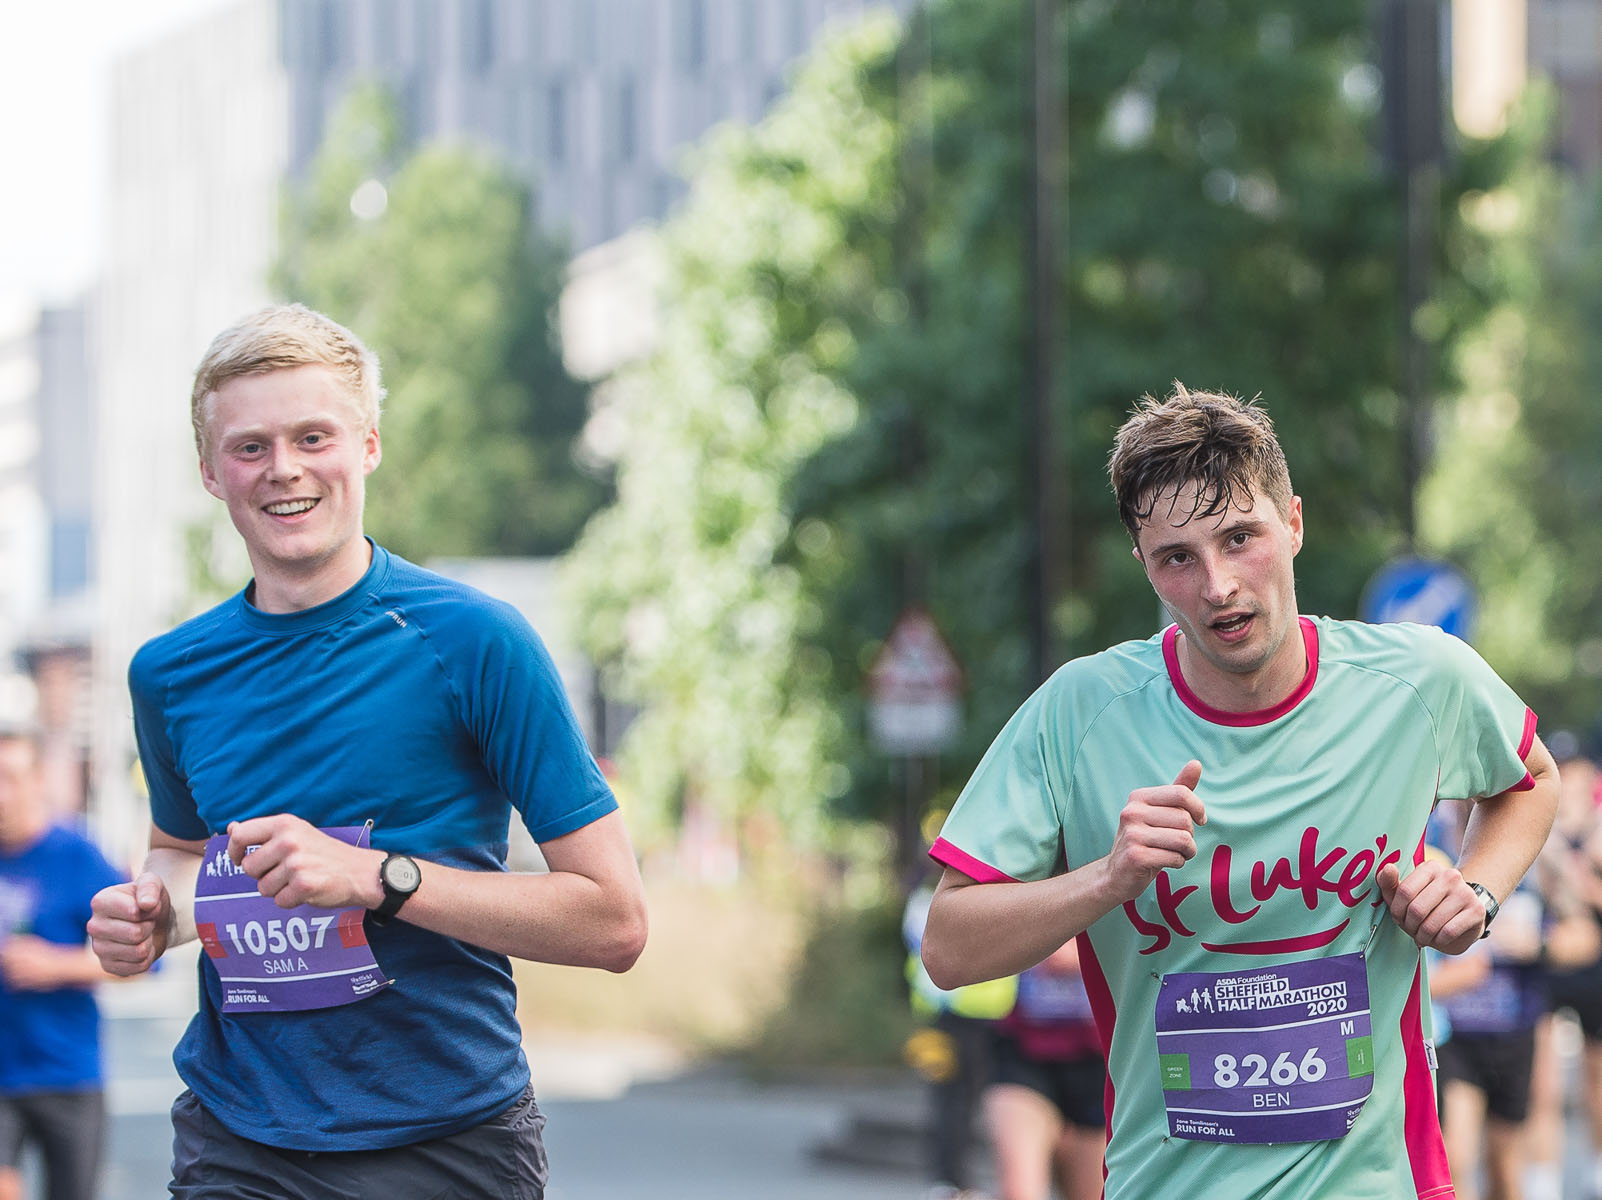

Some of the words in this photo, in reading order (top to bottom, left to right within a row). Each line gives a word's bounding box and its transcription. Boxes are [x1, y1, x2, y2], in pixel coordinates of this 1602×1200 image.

[226, 915, 336, 956] 10507
[263, 958, 295, 975] SAM
[297, 957, 309, 971] A
[1215, 977, 1237, 987] ASDA
[1237, 973, 1277, 984] Foundation
[1217, 979, 1287, 998] SHEFFIELD
[227, 994, 243, 1003] RUN
[244, 994, 257, 1003] FOR
[257, 994, 270, 1003] ALL
[1218, 997, 1256, 1012] HALF
[1258, 984, 1345, 1009] MARATHON
[1307, 1001, 1348, 1017] 2020
[1340, 1020, 1355, 1036] M
[1213, 1047, 1327, 1089] 8266
[1252, 1092, 1291, 1108] BEN
[1176, 1124, 1196, 1134] RUN
[1197, 1126, 1217, 1136] FOR
[1218, 1128, 1236, 1137] ALL
